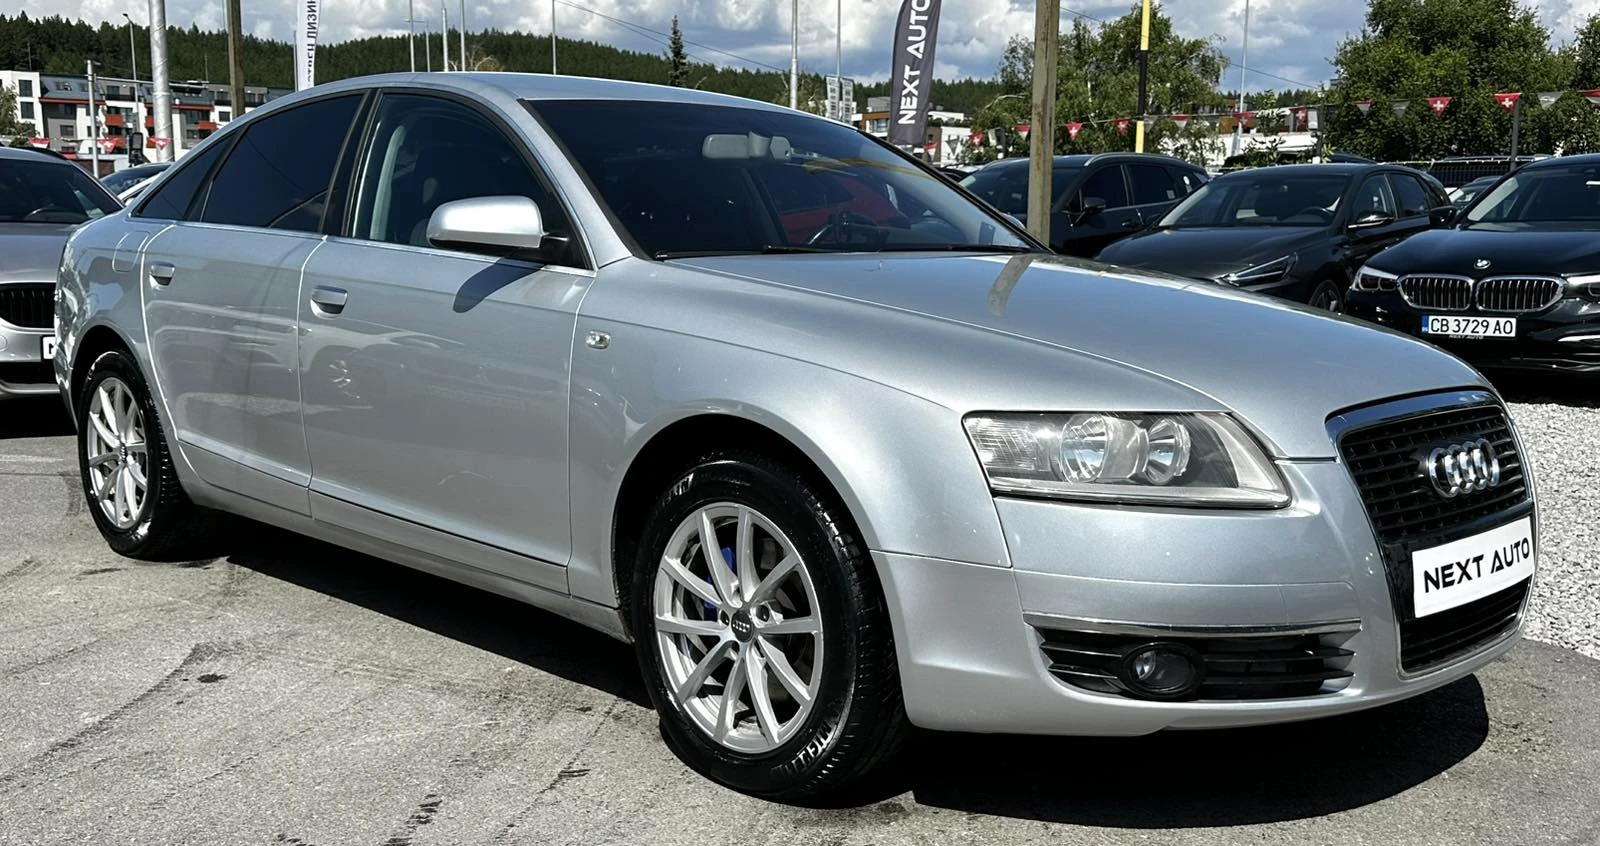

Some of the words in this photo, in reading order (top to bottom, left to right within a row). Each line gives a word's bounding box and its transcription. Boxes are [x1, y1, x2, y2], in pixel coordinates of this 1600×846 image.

[907, 0, 931, 59] AUTO
[898, 65, 920, 125] NEXT
[1430, 318, 1449, 332] CB
[1452, 319, 1489, 334] 3729
[1493, 320, 1513, 335] AO
[1423, 554, 1484, 593] NEXT
[1490, 537, 1530, 574] AUTO
